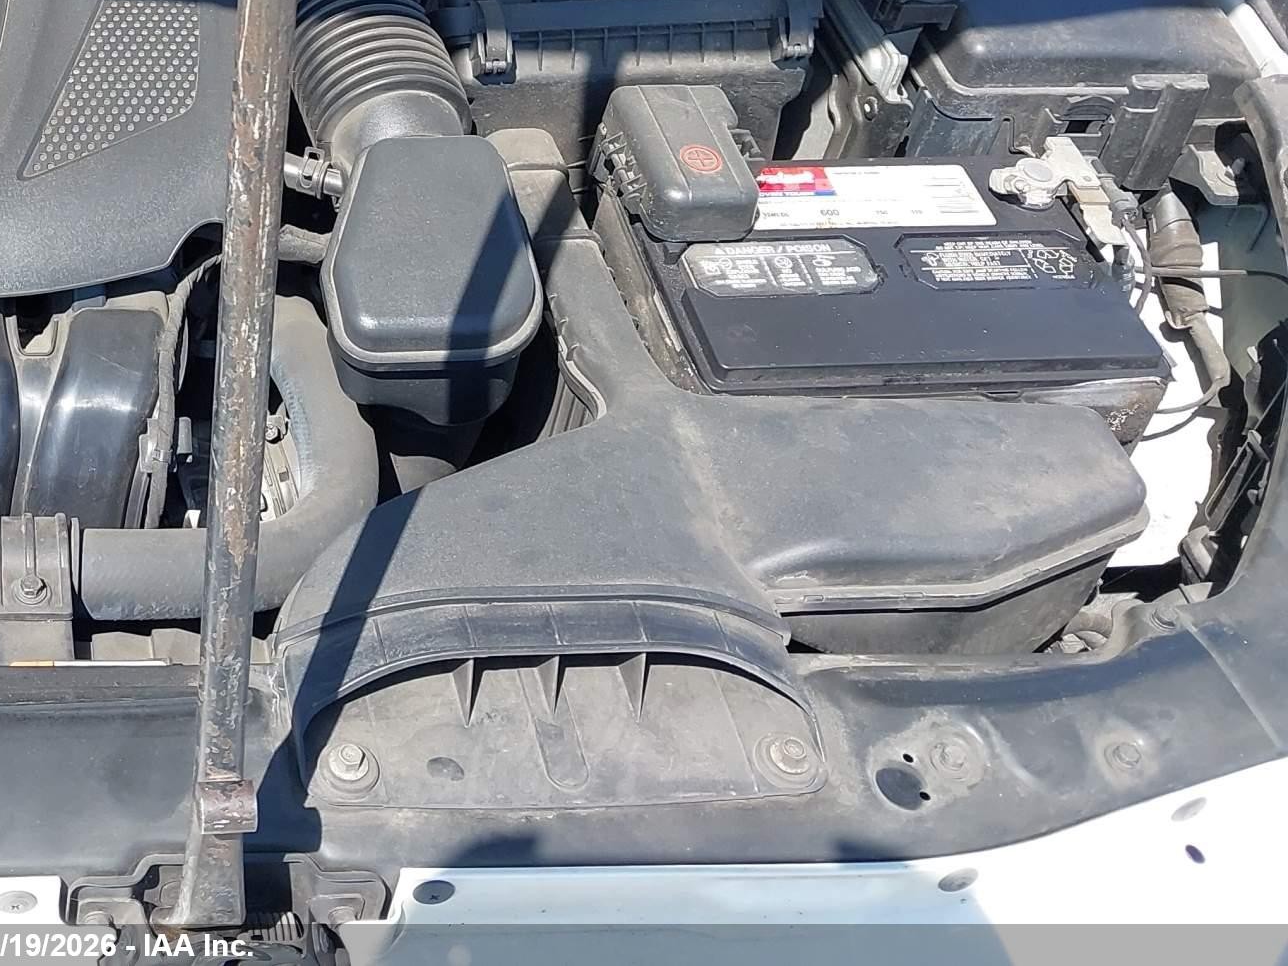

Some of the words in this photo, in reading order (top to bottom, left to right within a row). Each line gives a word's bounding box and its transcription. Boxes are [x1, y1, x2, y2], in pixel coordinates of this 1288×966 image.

[820, 209, 840, 217] 600
[728, 244, 776, 255] DANGER
[786, 242, 832, 253] POISON
